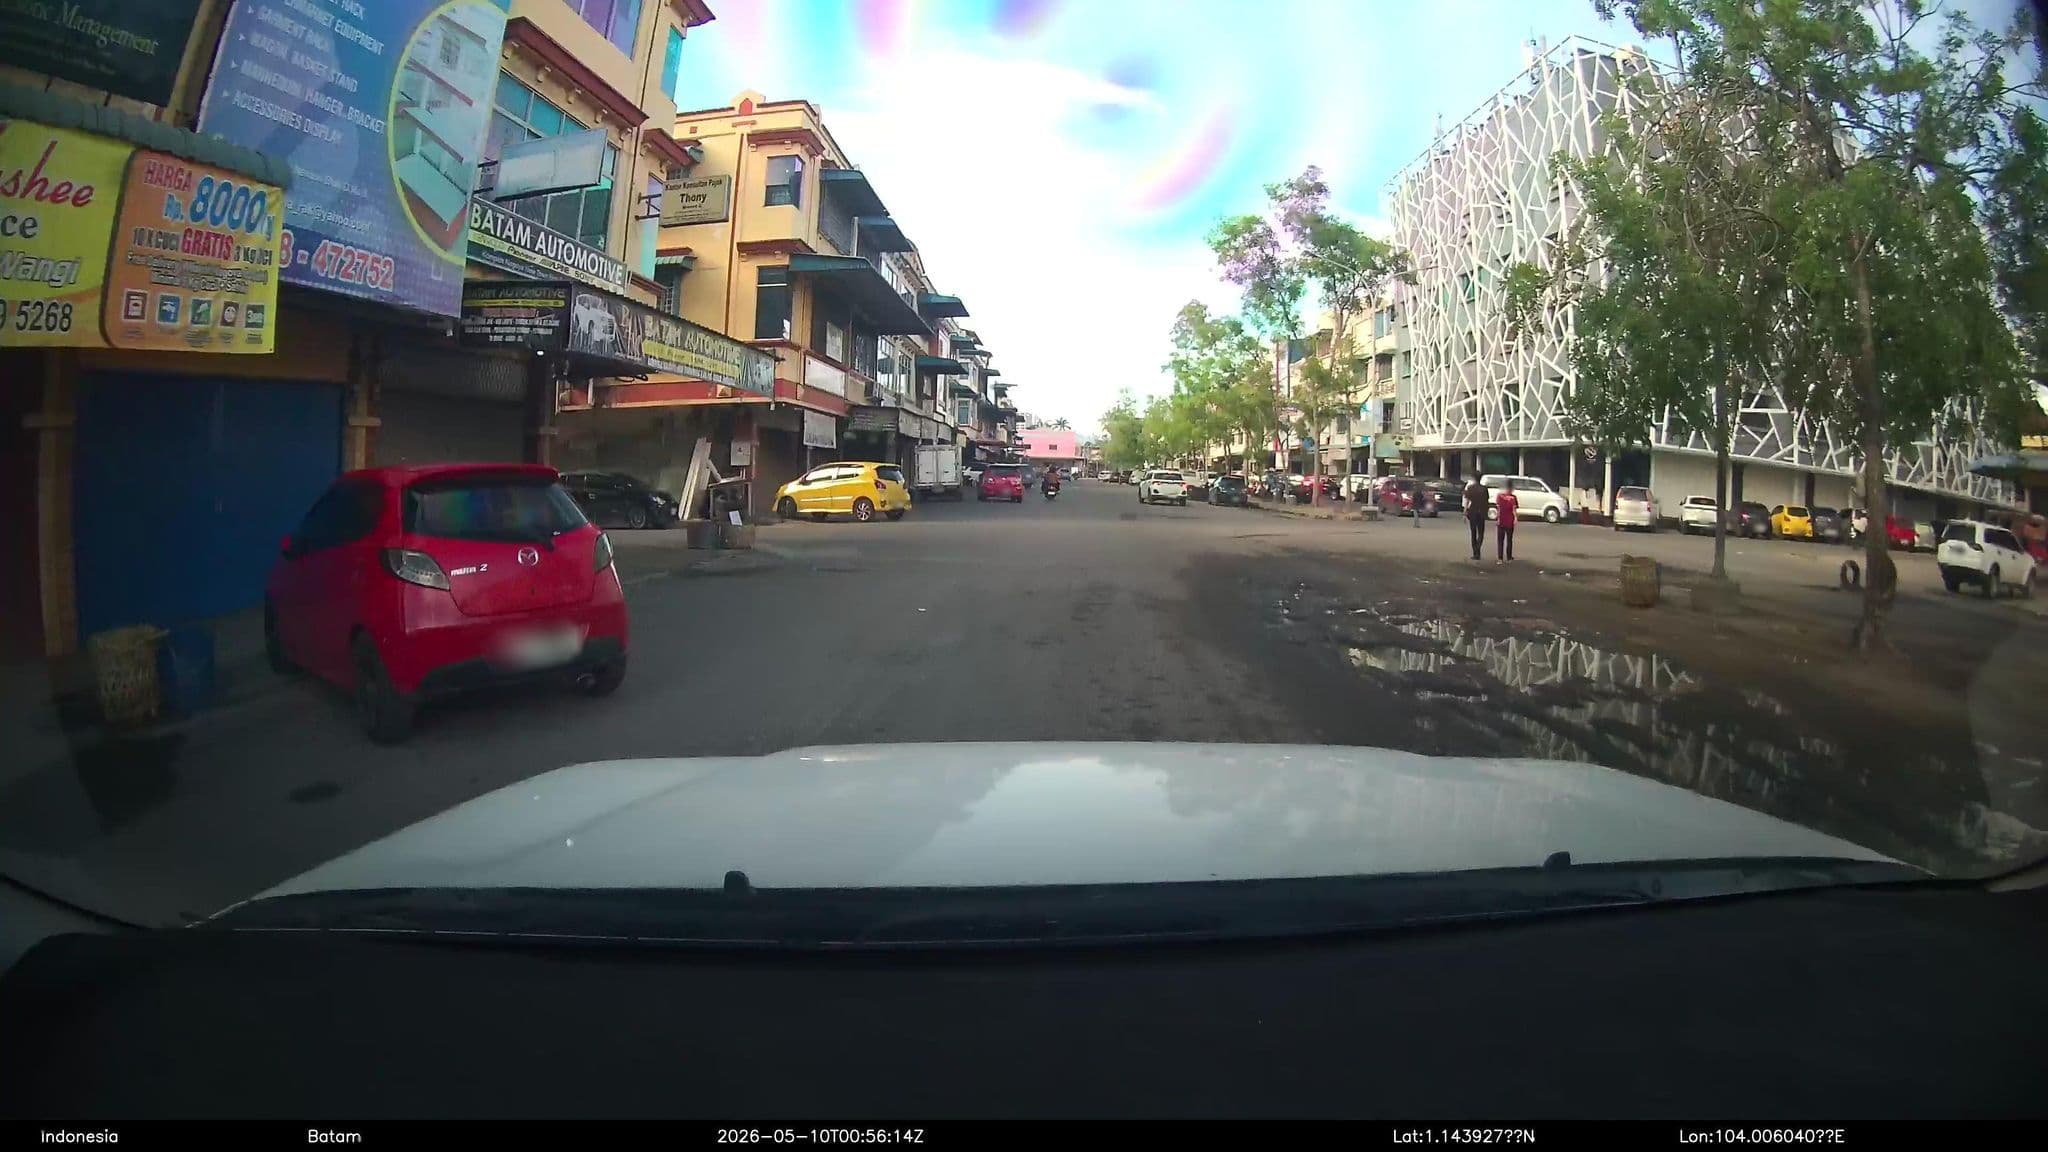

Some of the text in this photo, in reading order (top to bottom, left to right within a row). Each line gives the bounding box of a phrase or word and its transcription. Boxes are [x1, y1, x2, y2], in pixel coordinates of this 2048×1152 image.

[61, 1, 160, 57] Management
[334, 19, 385, 56] EQUIPMENT
[232, 90, 344, 145] ACCESSORIES DISPLAY
[0, 138, 95, 207] shee
[144, 160, 193, 192] HARGA
[188, 174, 267, 235] 8000
[680, 192, 708, 204] Thony
[181, 226, 235, 261] GRATIS
[470, 202, 624, 286] BATAM AUTOMOTIVE
[312, 239, 396, 293] 472752
[15, 299, 73, 333] 5268
[644, 314, 682, 348] BATAM
[479, 563, 489, 572] 2
